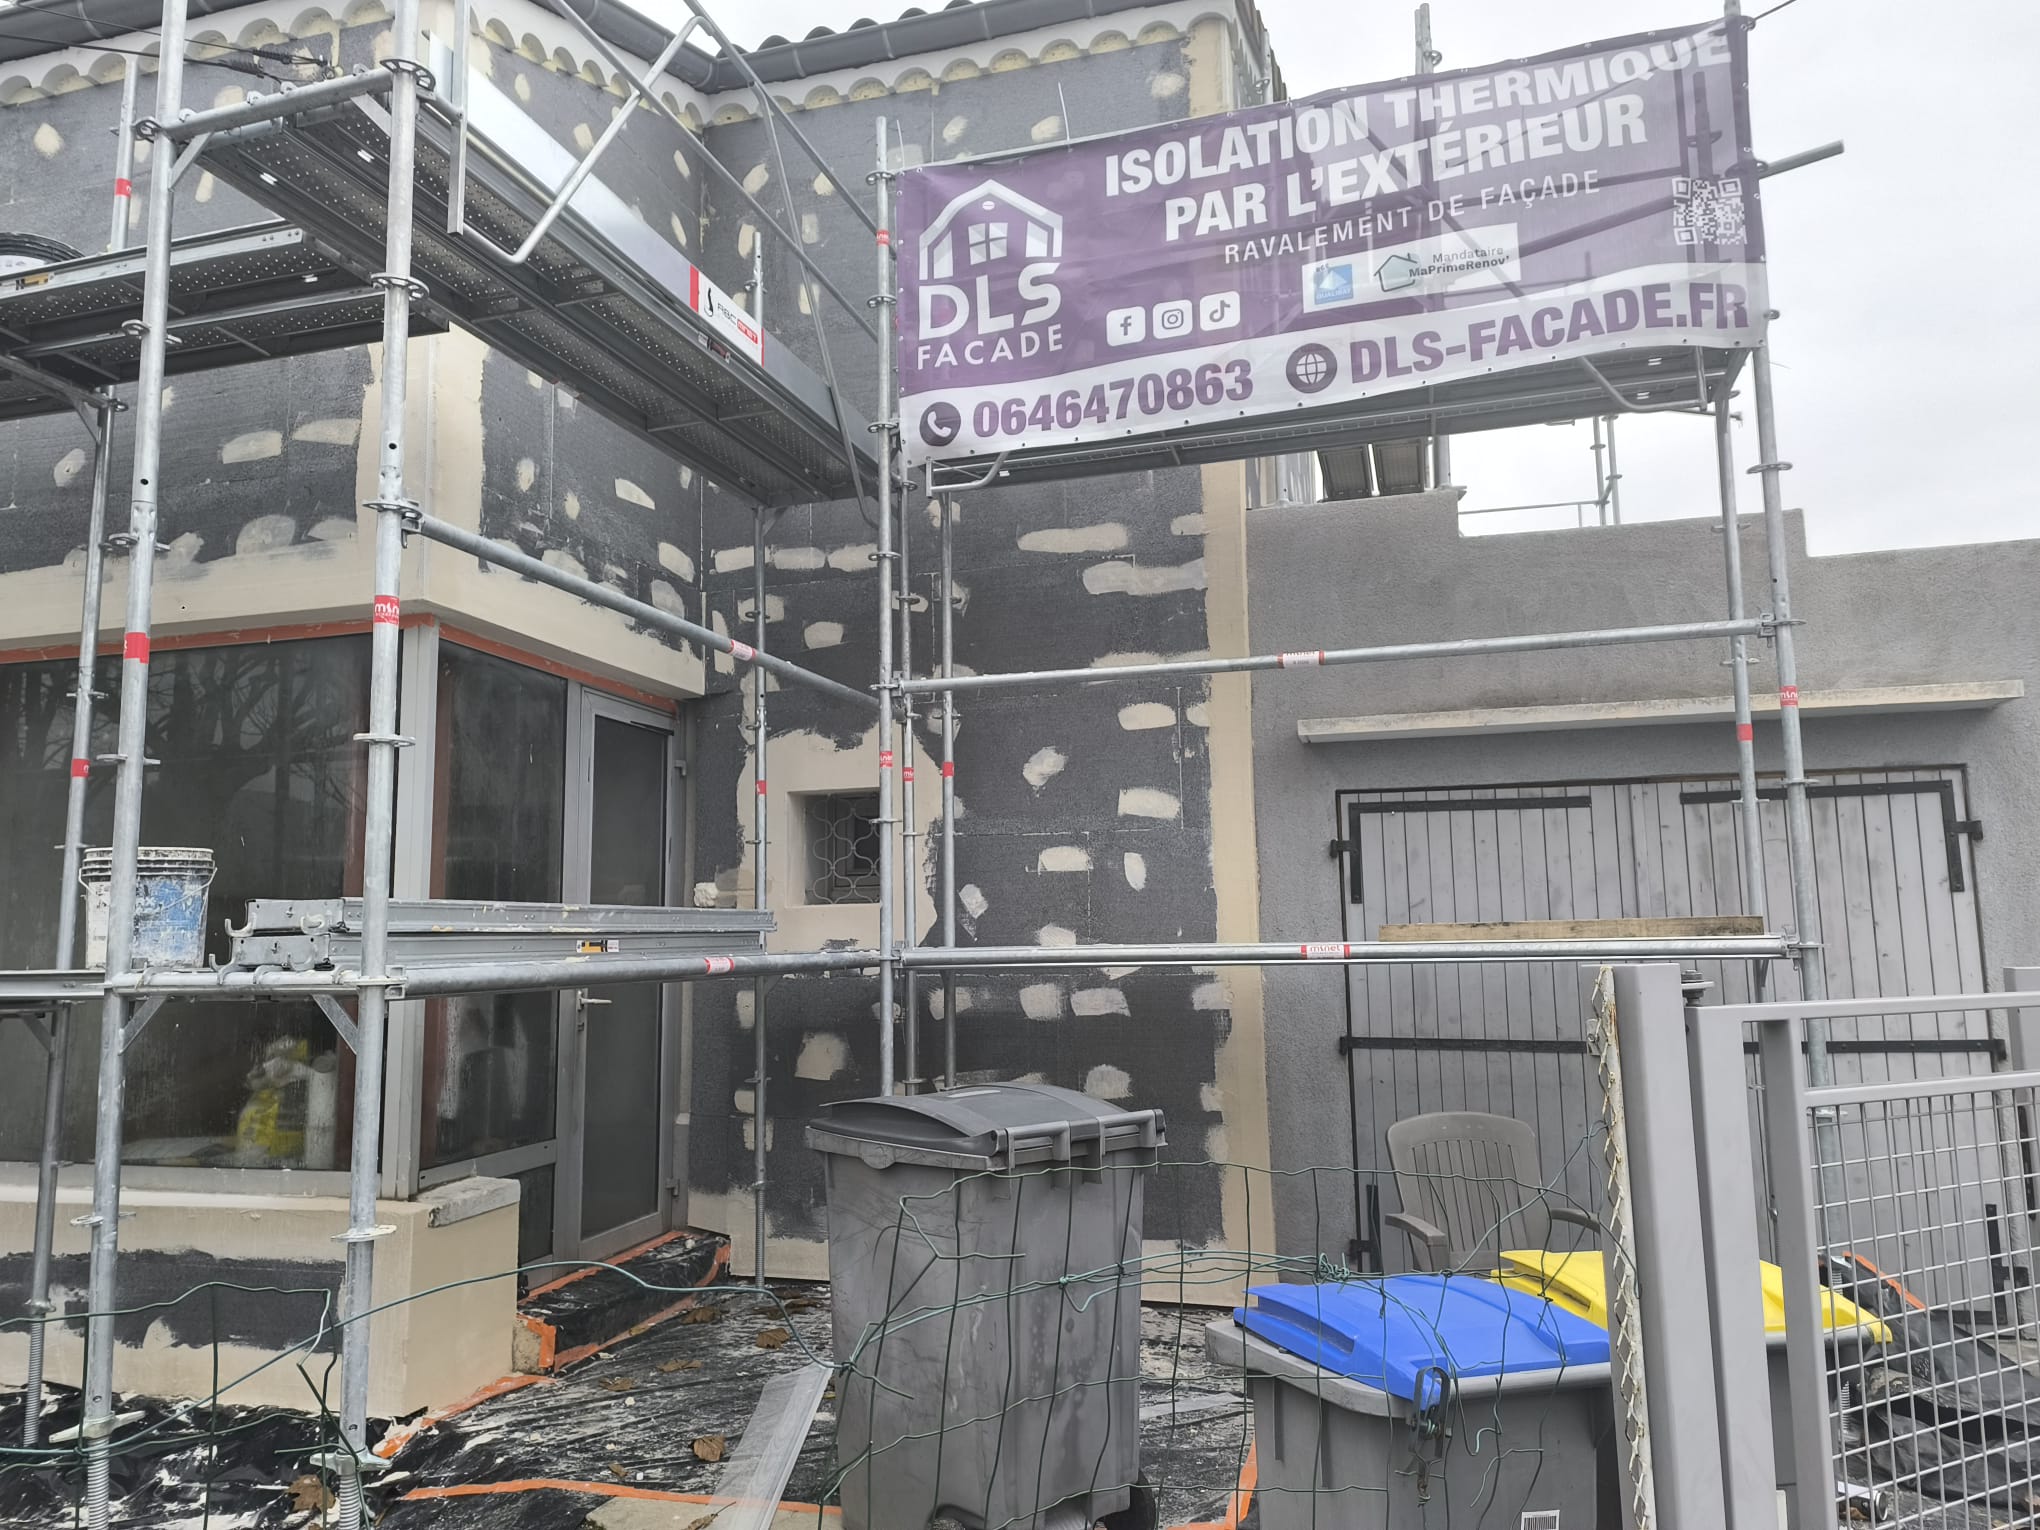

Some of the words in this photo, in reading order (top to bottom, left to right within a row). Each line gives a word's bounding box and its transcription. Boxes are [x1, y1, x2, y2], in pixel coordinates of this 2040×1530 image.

[1105, 95, 1369, 197] ISOLATION
[1383, 21, 1732, 129] THERMIQUE
[1165, 182, 1268, 242] PAR
[1286, 93, 1648, 218] L'EXTÉRIEUR
[1224, 206, 1412, 265] RAVALEMENT
[1427, 194, 1465, 222] DE
[1480, 169, 1601, 210] FAÇADE
[1432, 246, 1504, 264] Mandataire
[918, 262, 1062, 341] DLS
[1350, 281, 1750, 385] DLS-FACADE.FR
[917, 323, 1063, 371] FACADE
[972, 358, 1254, 438] 0646470863
